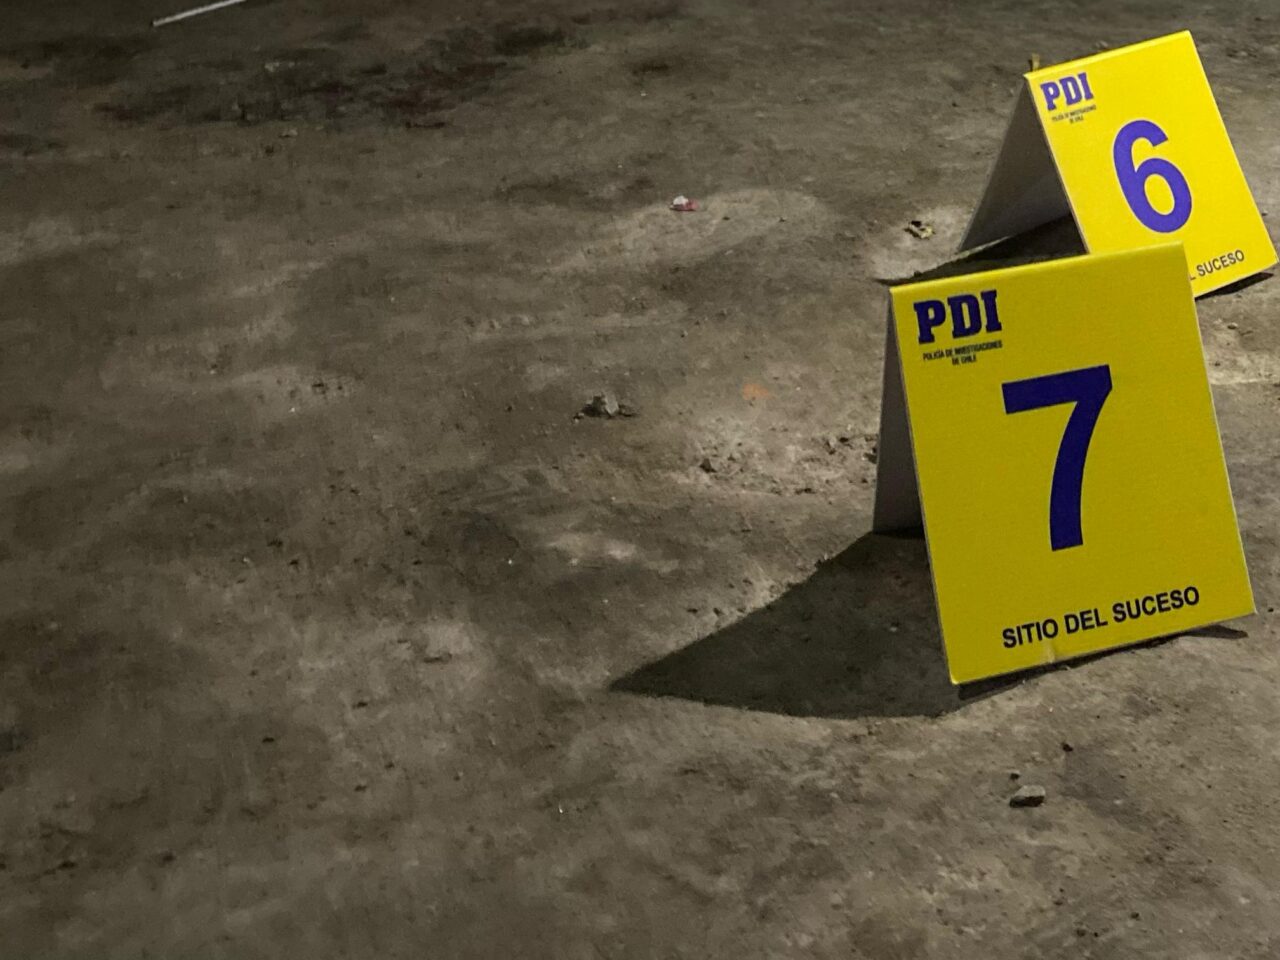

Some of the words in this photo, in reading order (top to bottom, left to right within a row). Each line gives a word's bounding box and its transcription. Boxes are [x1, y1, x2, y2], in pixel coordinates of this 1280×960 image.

[1040, 72, 1095, 111] PDI
[1113, 119, 1192, 233] 6
[1196, 249, 1245, 277] SUCESO
[913, 289, 1002, 345] PDI
[1001, 364, 1113, 551] 7
[1002, 619, 1060, 649] SITIO
[1064, 608, 1108, 635] DEL
[1112, 586, 1200, 623] SUCESO
